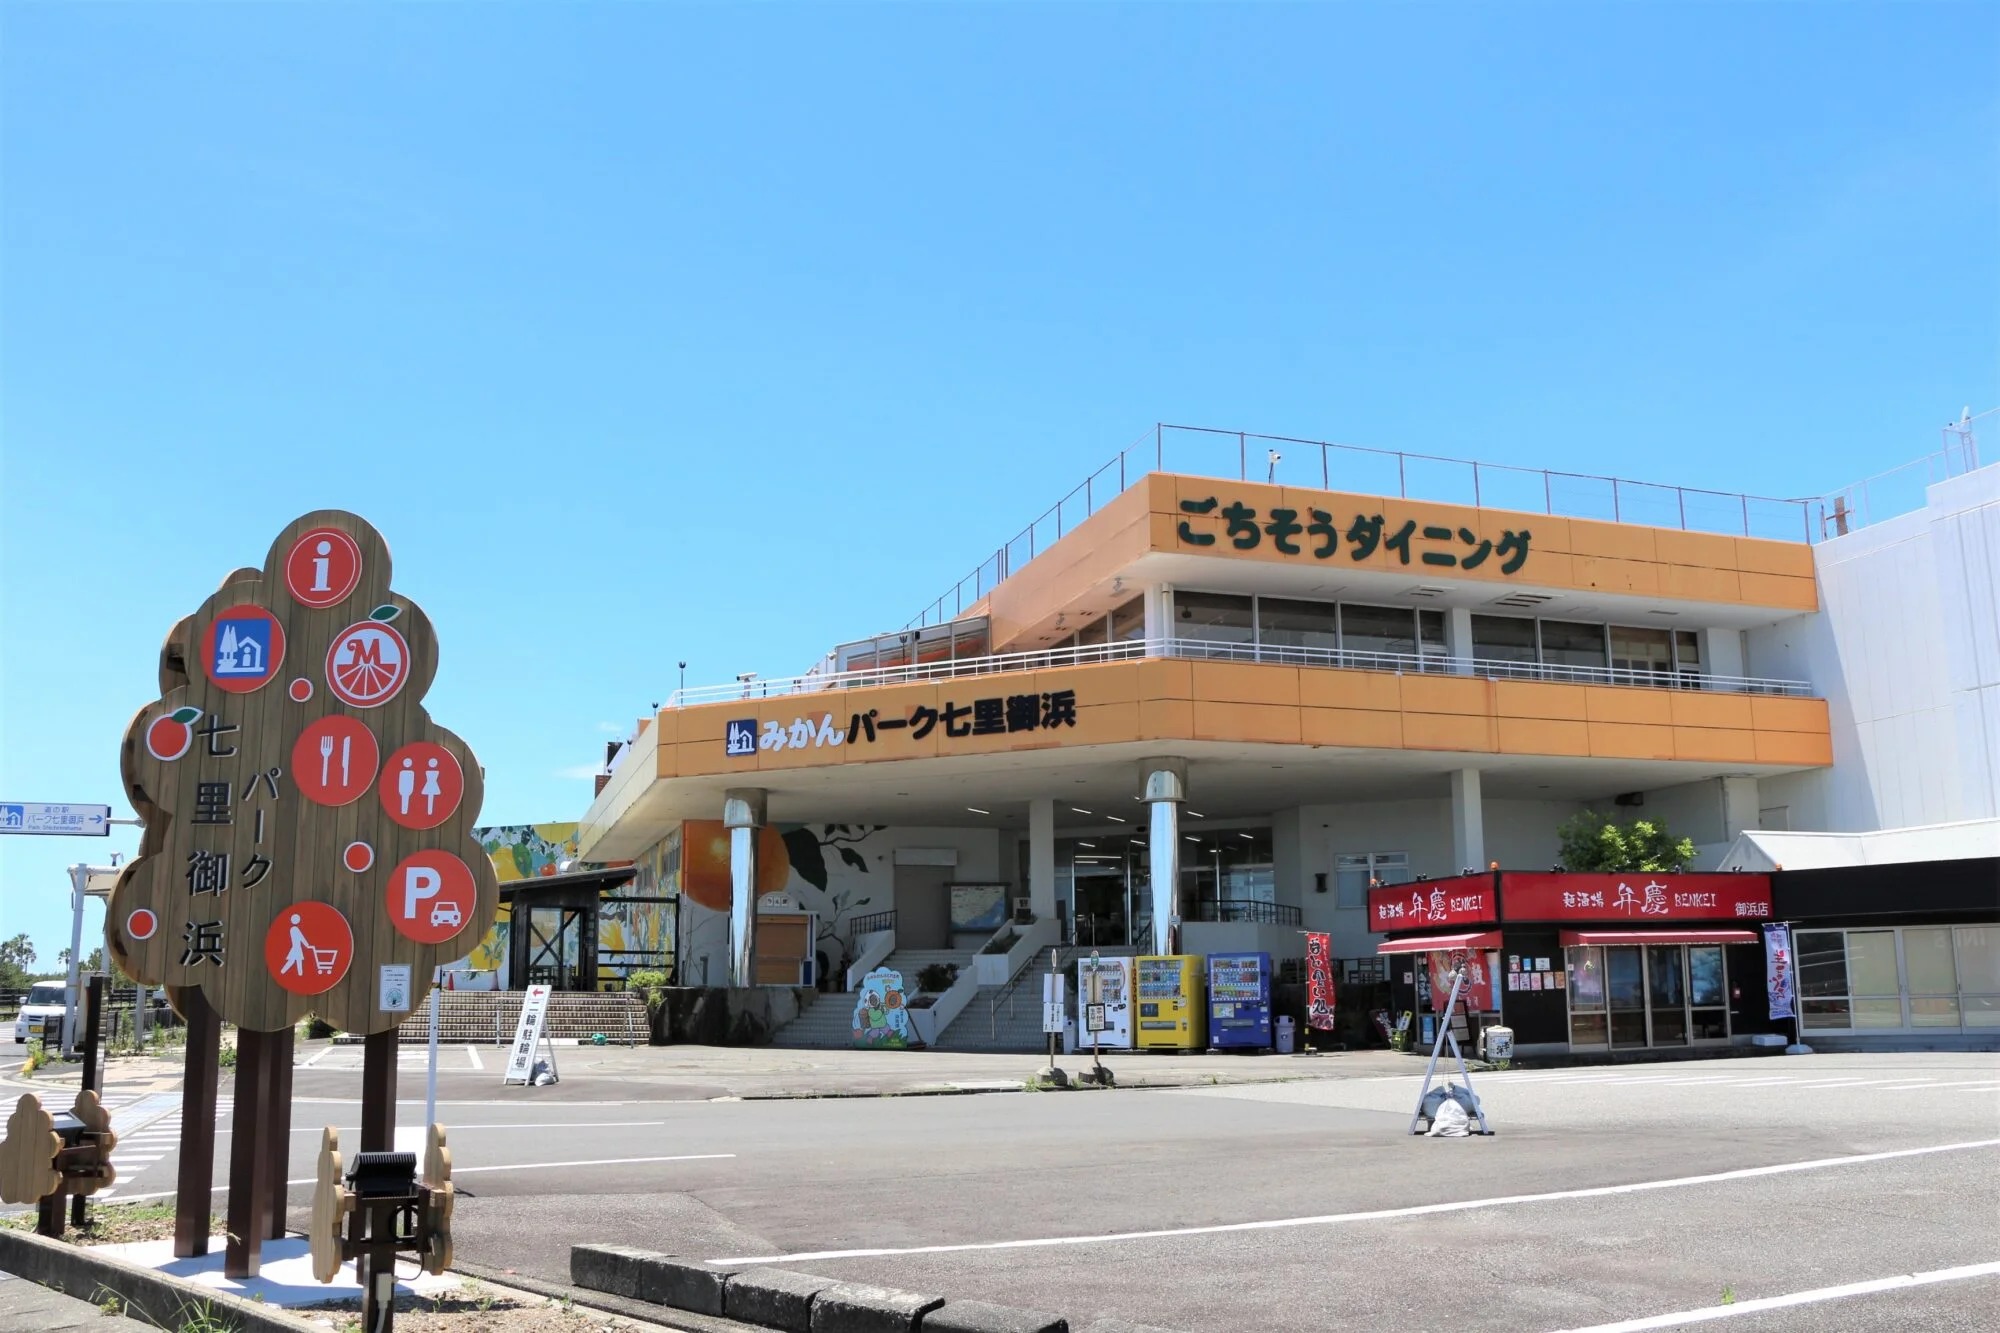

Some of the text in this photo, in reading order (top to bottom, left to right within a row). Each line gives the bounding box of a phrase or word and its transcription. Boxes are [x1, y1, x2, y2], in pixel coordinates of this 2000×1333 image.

[1178, 496, 1532, 575] ごちそうダイニング
[27, 815, 84, 825] パーク七里御浜
[179, 714, 241, 968] 七里御浜
[241, 766, 282, 890] パーク
[1408, 887, 1447, 923] 弁慶
[1450, 895, 1482, 912] BENKEI
[1612, 880, 1669, 915] 弁慶
[1674, 893, 1716, 907] BENKEI
[1735, 902, 1769, 916] 御浜店
